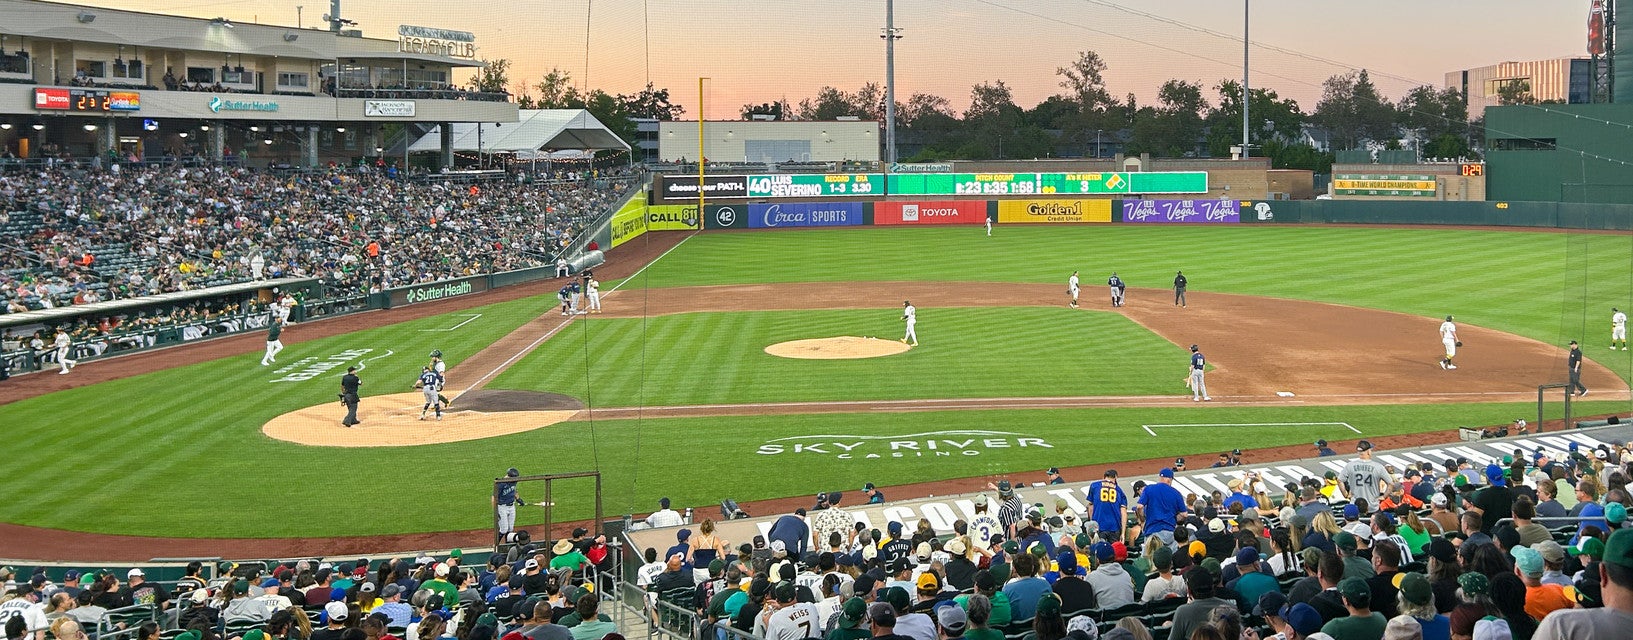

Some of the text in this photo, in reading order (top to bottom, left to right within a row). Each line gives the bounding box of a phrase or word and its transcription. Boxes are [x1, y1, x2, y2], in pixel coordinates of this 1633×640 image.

[399, 36, 475, 58] LEGACY CLUB
[89, 98, 96, 108] 3
[225, 100, 279, 112] Sutter Health
[900, 164, 951, 172] Sutter Health
[1462, 164, 1482, 176] 0:29
[771, 175, 793, 185] LUIS
[825, 175, 868, 183] RECORD ERA
[975, 174, 1015, 182] PITCH COUNT
[669, 182, 697, 192] choose
[749, 177, 771, 194] 40
[770, 184, 822, 196] SEVERINO
[829, 183, 872, 193] 1-3 3.30
[1080, 180, 1089, 192] 3
[1369, 181, 1387, 189] WORLD
[1387, 181, 1417, 189] CHAMPIONS
[649, 213, 680, 223] CALL
[682, 208, 698, 220] 811
[719, 211, 733, 222] 42
[764, 204, 847, 227] Circa SPORTS
[921, 208, 959, 217] TOYOTA
[1124, 201, 1161, 221] Vegas
[1162, 201, 1199, 221] Vegas
[1201, 201, 1239, 221] Vegas
[416, 281, 472, 302] Sutter Health
[756, 437, 1055, 455] SKY RIVER
[837, 450, 980, 459] CASINO
[1353, 464, 1374, 472] GRIFFEY
[1355, 473, 1373, 487] 24
[1100, 487, 1117, 503] 68
[970, 516, 997, 530] CRAWFORD
[980, 526, 990, 542] 3
[888, 543, 909, 552] GRIFFEY
[788, 609, 810, 622] WEISS
[798, 620, 811, 638] 7
